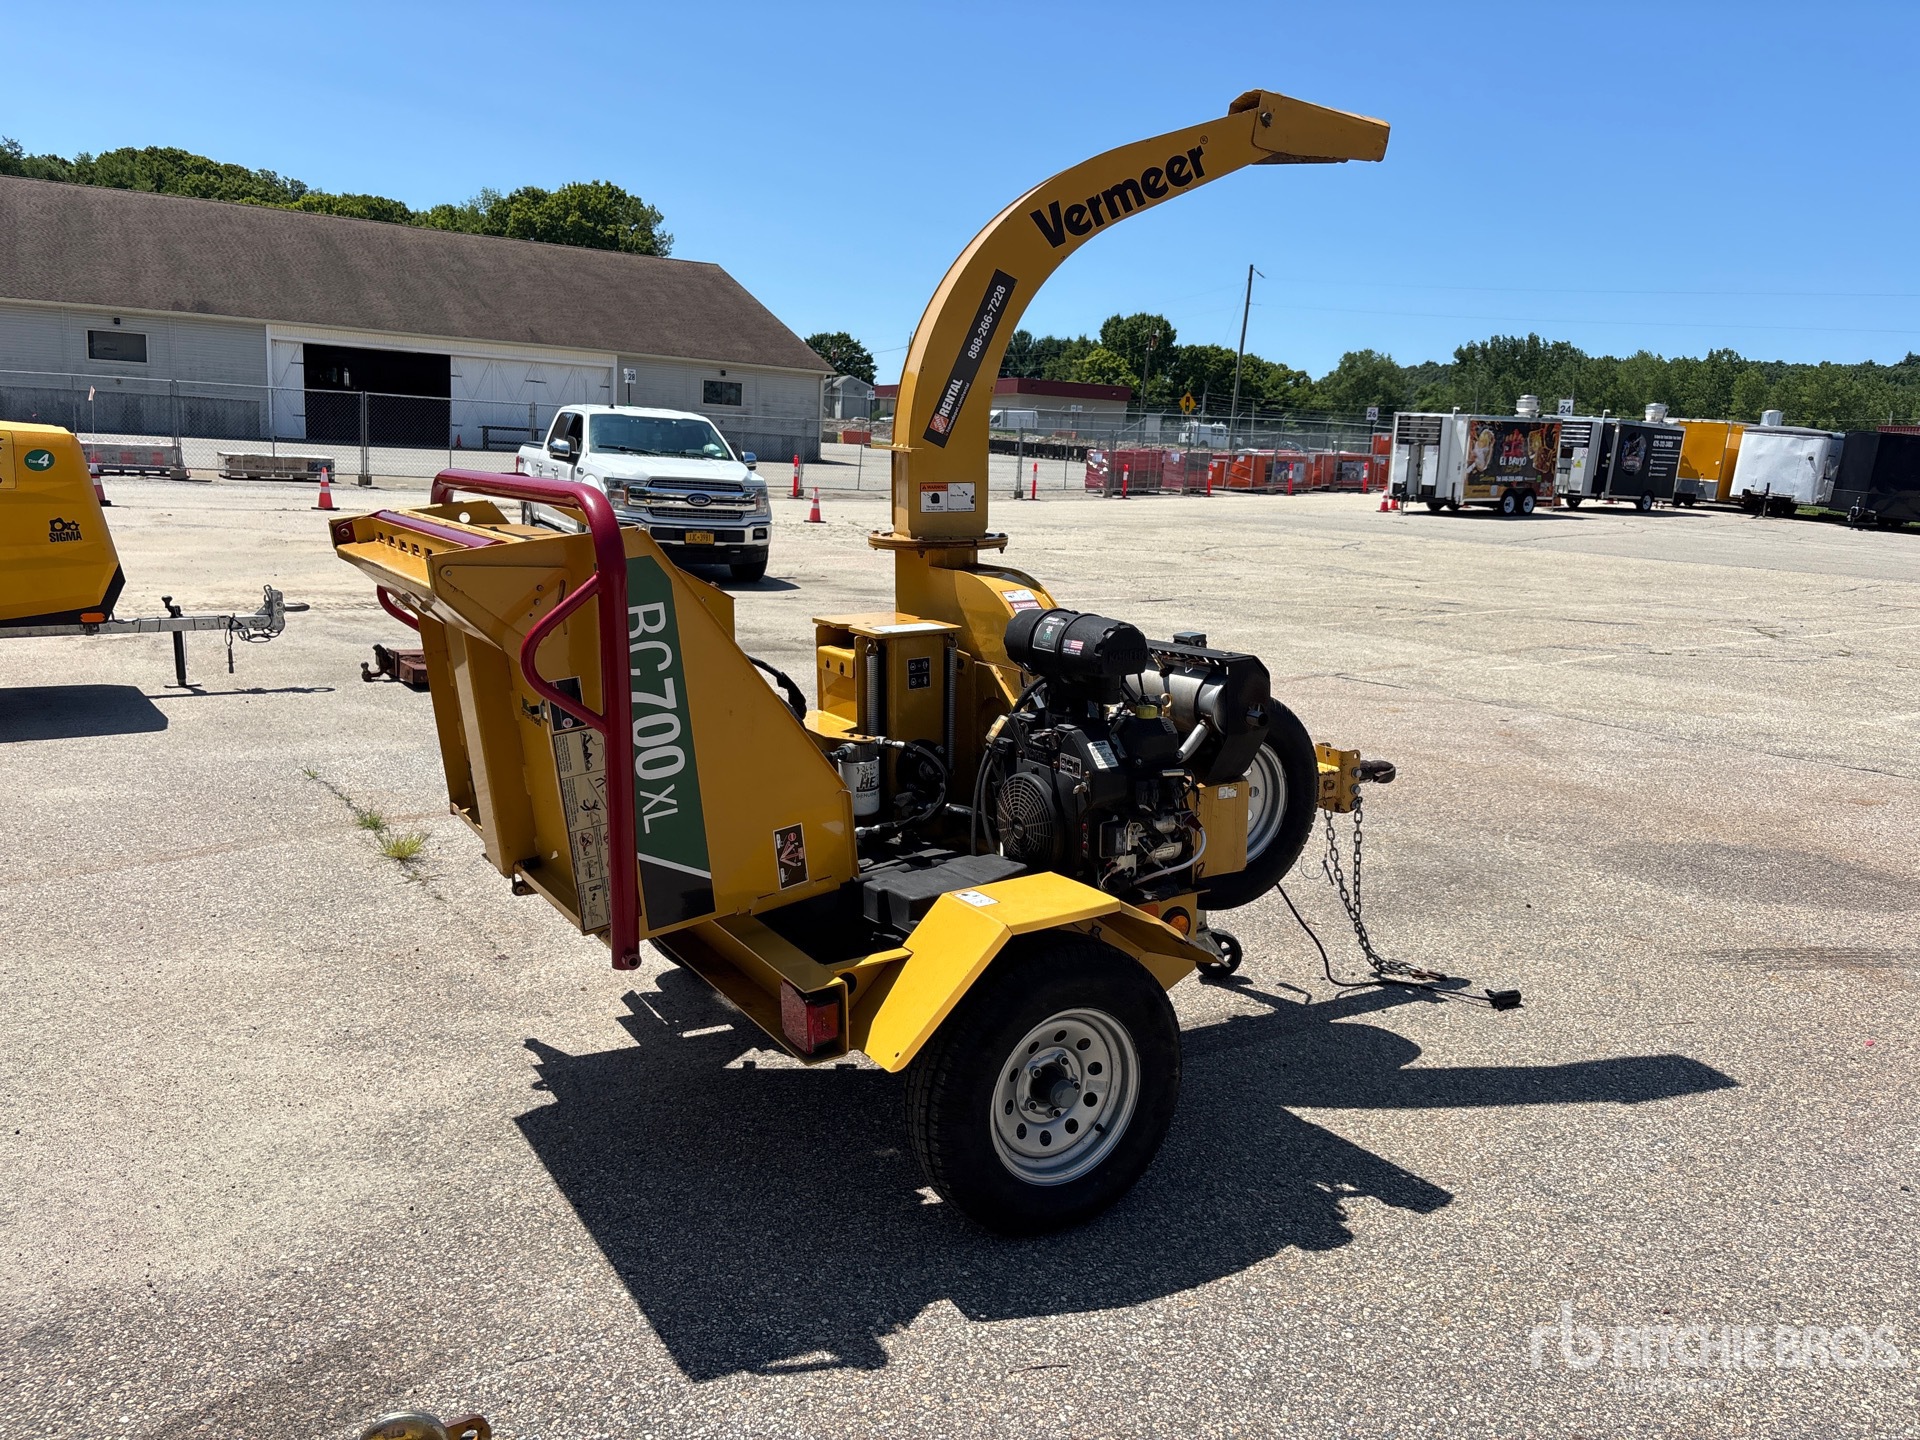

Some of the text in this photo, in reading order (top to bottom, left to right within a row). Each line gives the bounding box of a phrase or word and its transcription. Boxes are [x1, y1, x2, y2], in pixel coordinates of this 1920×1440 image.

[1029, 145, 1206, 249] Vermeer
[967, 285, 1006, 360] 888-266-7228
[939, 378, 964, 417] RENTAL
[1559, 405, 1571, 413] 24
[49, 530, 82, 543] SIGMA
